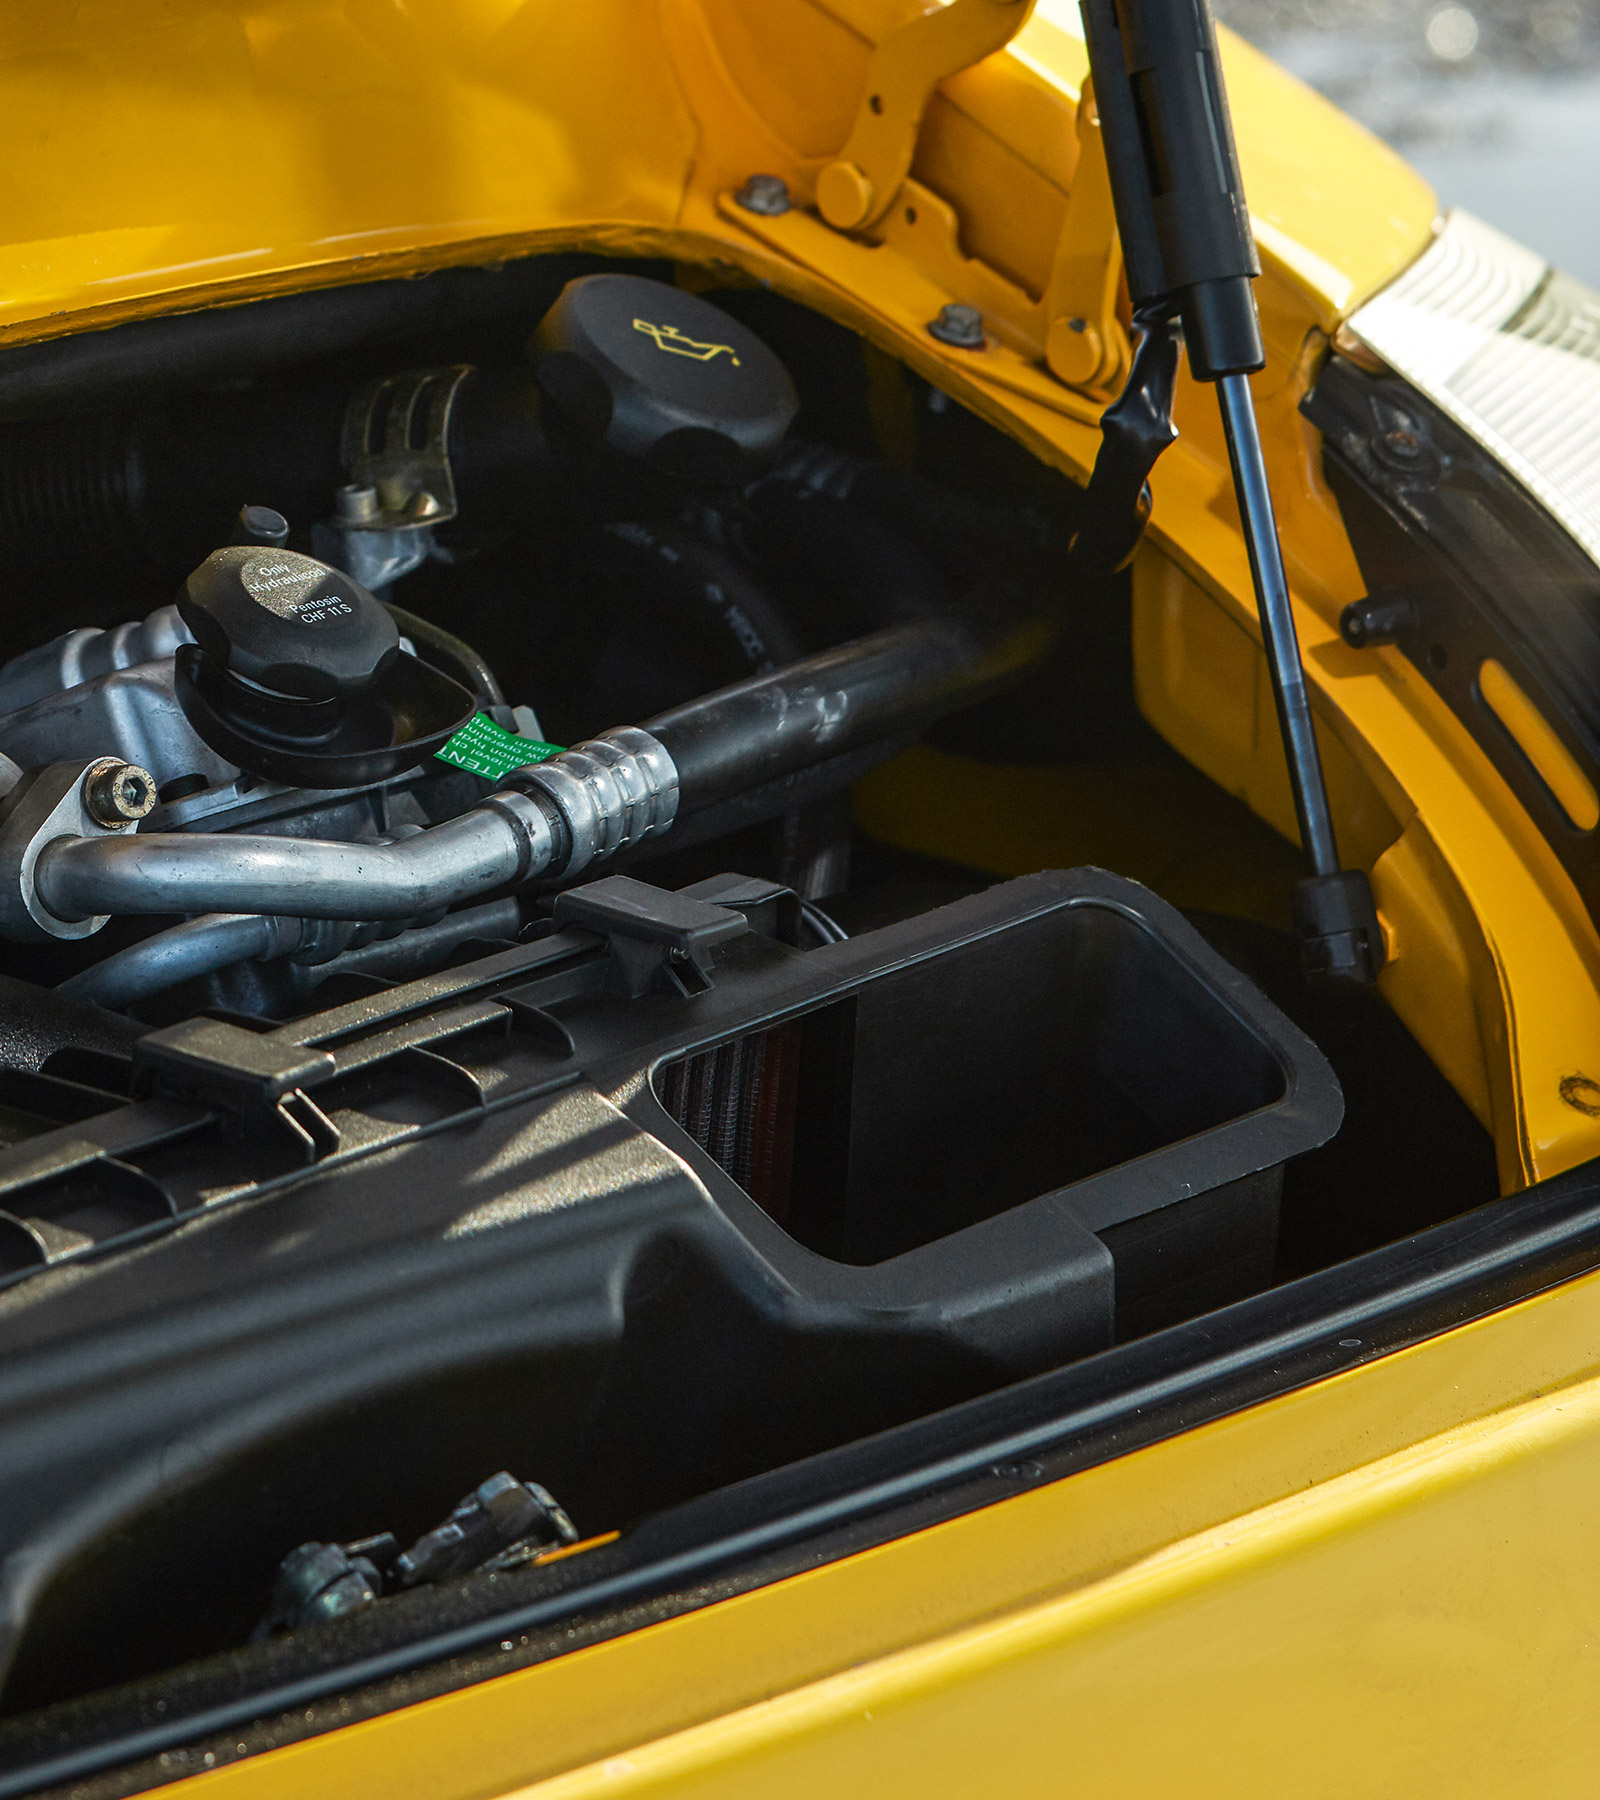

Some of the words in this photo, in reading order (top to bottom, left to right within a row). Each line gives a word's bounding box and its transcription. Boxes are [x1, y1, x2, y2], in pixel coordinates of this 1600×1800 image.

[259, 563, 291, 577] Only
[289, 595, 342, 614] Pentosin
[301, 610, 326, 624] CHF
[327, 606, 342, 617] 11
[340, 603, 353, 614] S
